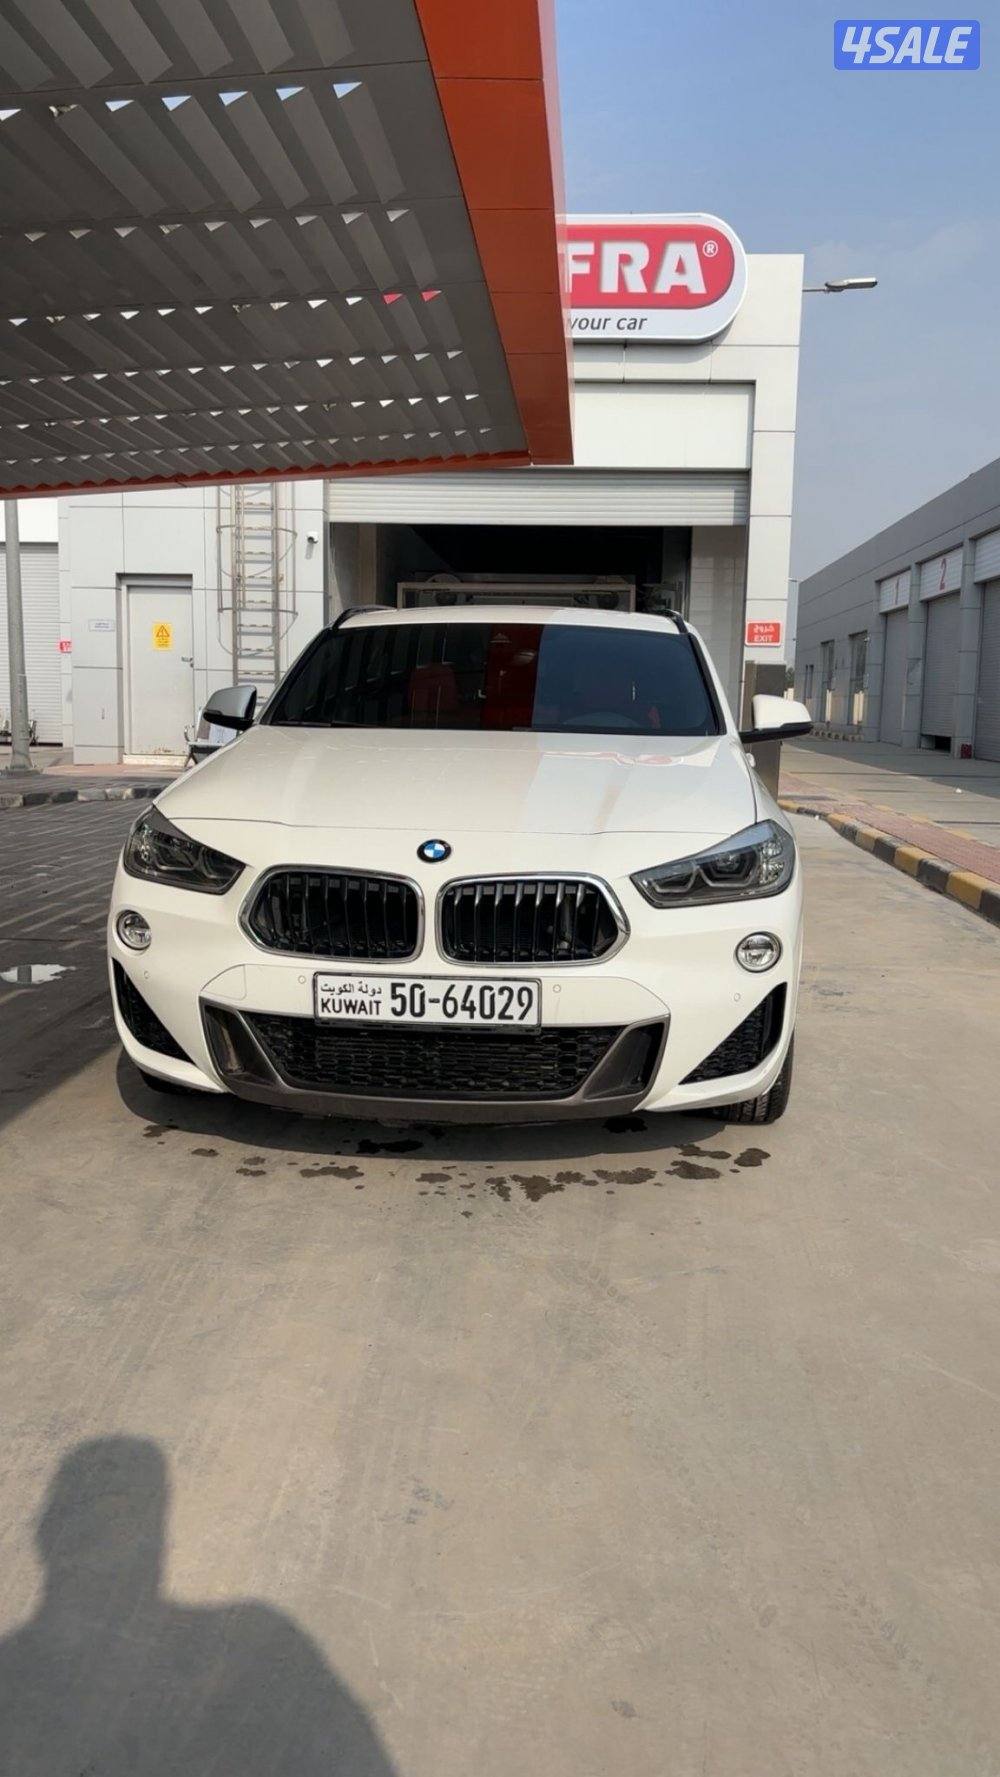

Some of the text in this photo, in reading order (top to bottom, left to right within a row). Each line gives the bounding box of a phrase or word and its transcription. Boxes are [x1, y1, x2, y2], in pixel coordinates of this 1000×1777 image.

[616, 317, 648, 331] car
[939, 558, 947, 591] 2
[320, 980, 382, 997] دولة الكويت
[320, 997, 382, 1016] KUWAIT
[391, 982, 533, 1020] 50-64029
